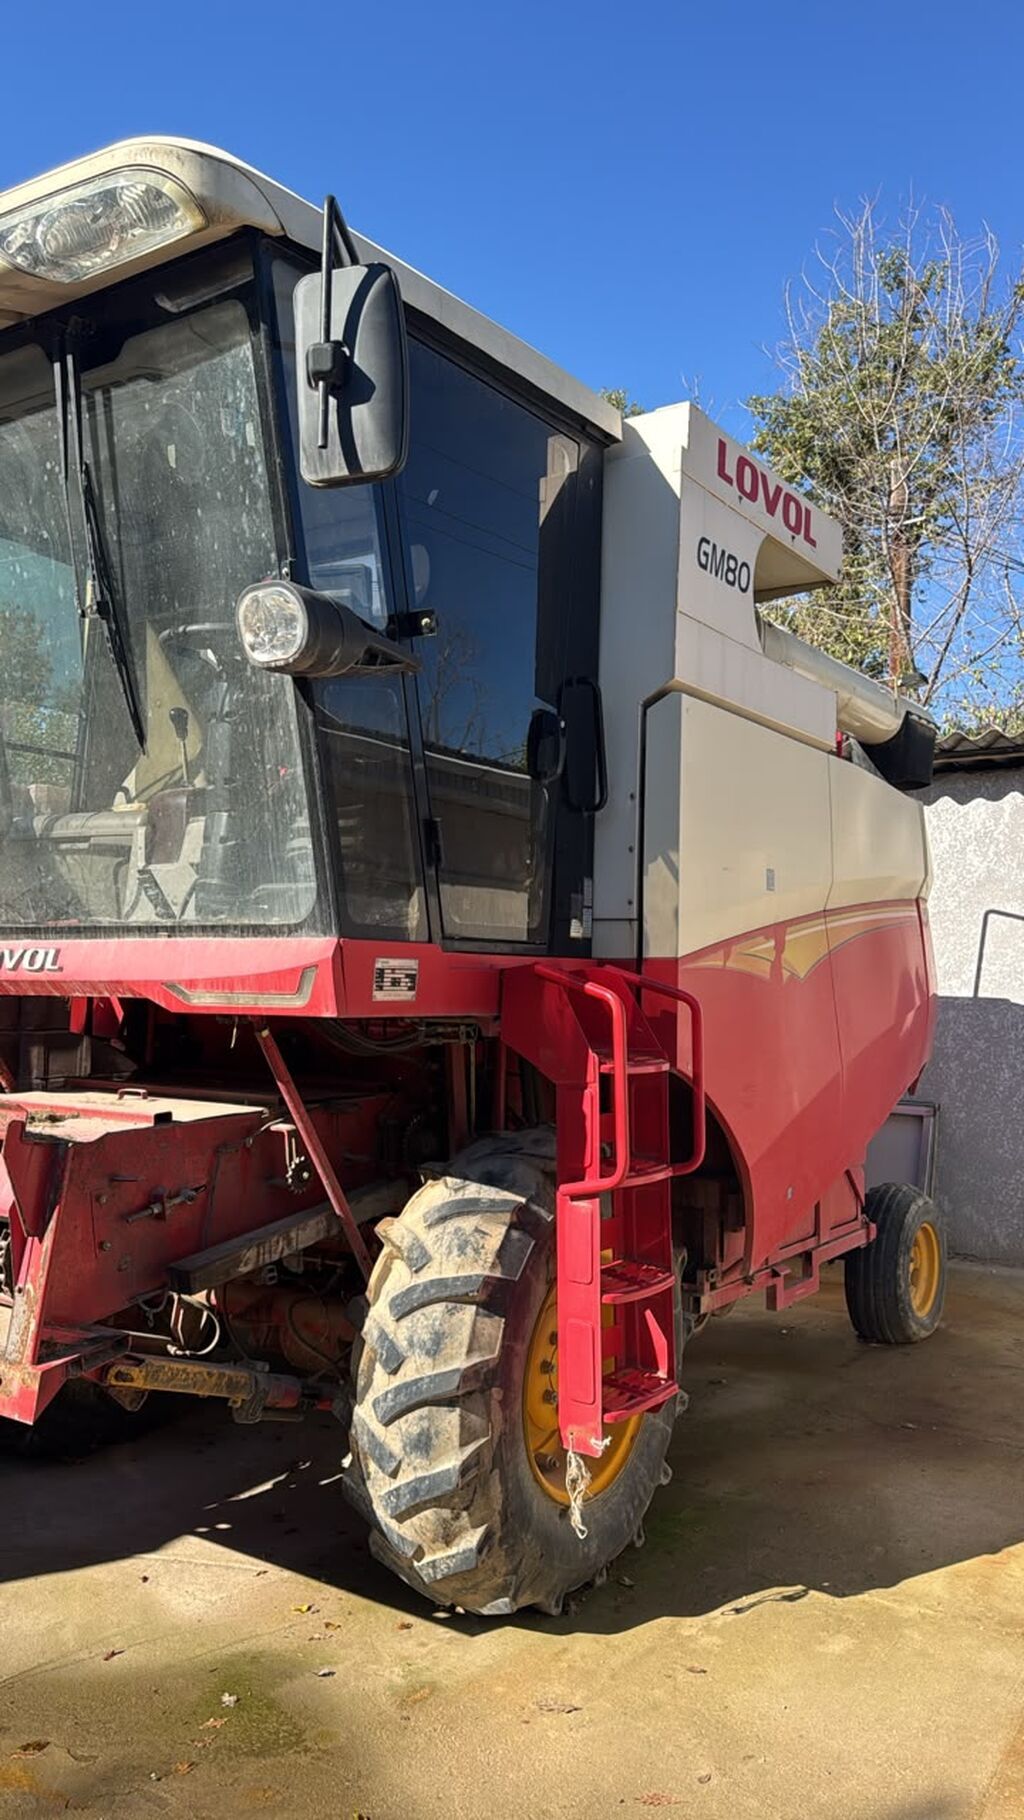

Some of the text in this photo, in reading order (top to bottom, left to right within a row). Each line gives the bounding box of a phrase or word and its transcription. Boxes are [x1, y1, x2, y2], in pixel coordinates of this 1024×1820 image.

[717, 438, 817, 548] LOVOL
[697, 536, 750, 593] GM80
[0, 948, 63, 972] VOL
